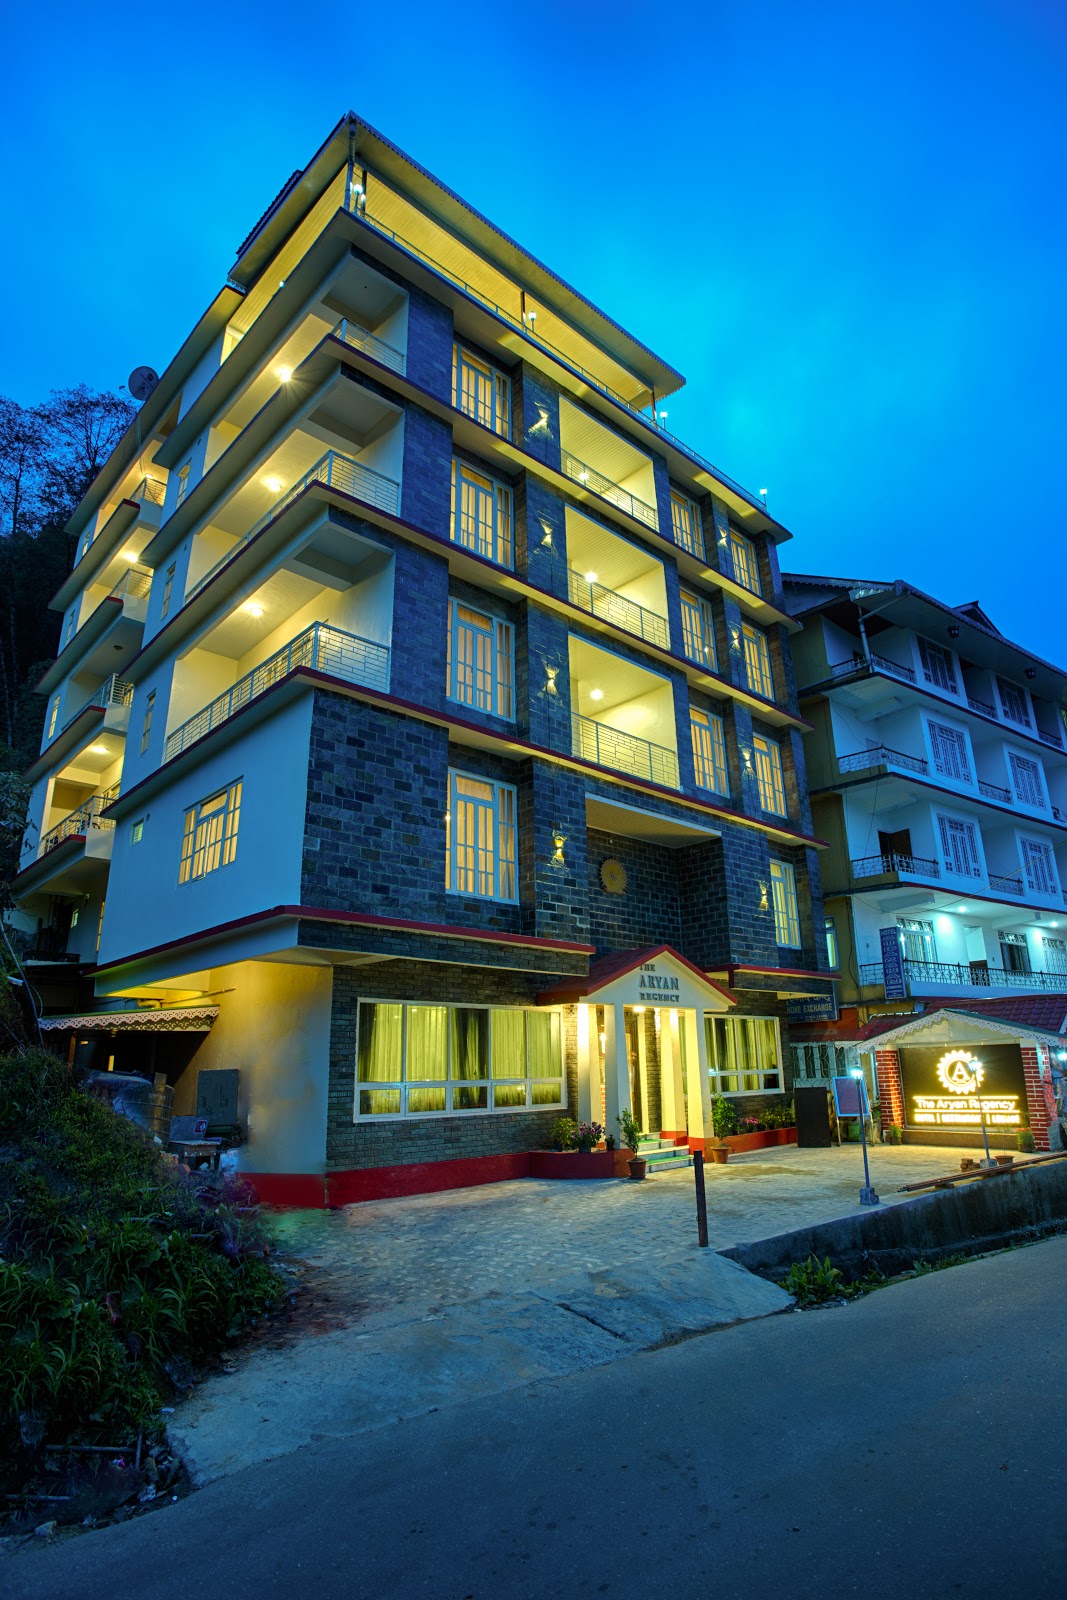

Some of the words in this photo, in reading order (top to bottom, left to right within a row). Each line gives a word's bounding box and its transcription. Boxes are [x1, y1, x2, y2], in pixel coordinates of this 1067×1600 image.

[640, 963, 655, 972] THE
[640, 974, 679, 990] ARYAN
[640, 992, 680, 1002] REGENCY
[786, 1005, 801, 1014] HONE
[803, 1003, 833, 1013] EXCHANGE
[915, 1099, 935, 1109] The
[936, 1099, 967, 1110] Aryan
[969, 1099, 1015, 1111] Regency
